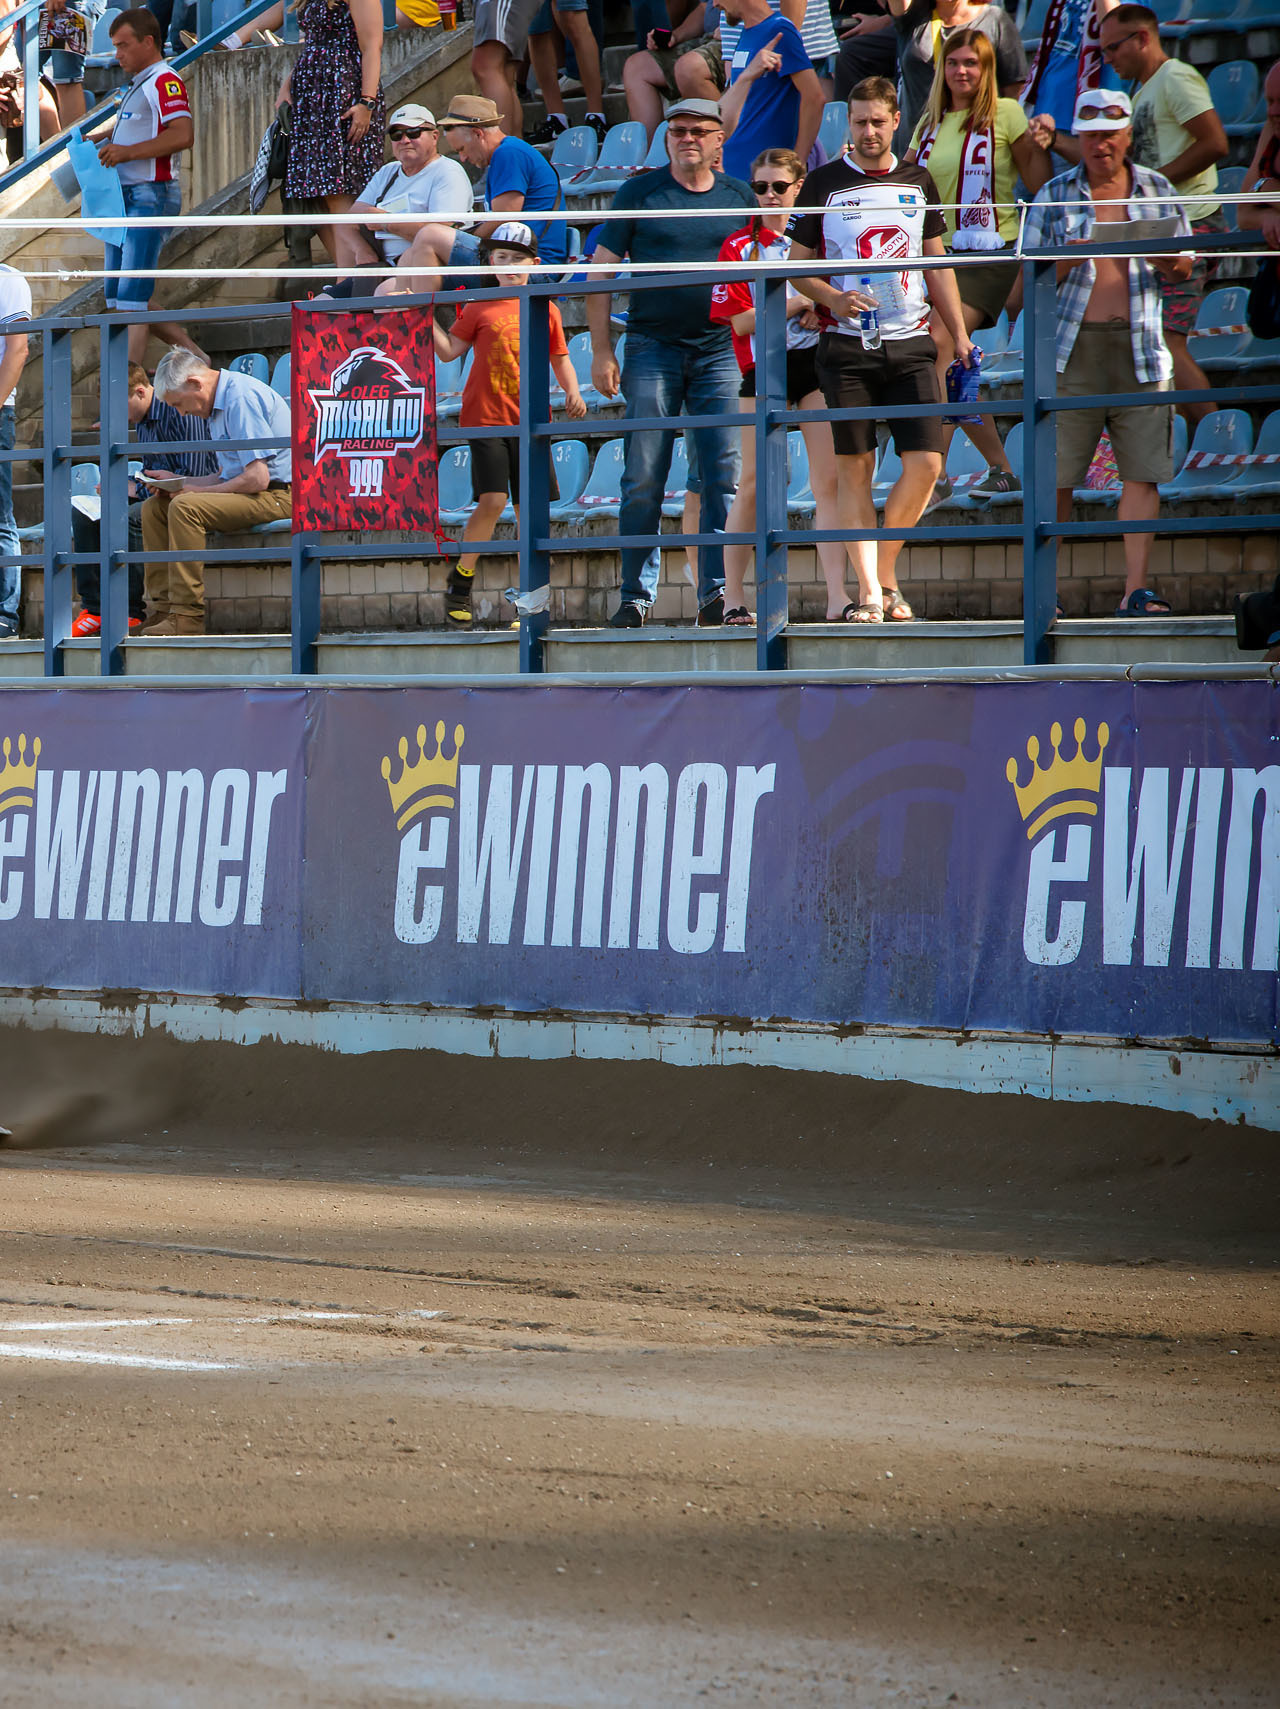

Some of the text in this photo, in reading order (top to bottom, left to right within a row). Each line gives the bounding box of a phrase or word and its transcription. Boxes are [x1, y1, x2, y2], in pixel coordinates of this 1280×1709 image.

[351, 384, 390, 400] OLEG
[343, 438, 395, 450] RACING
[454, 450, 468, 467] 37
[348, 458, 384, 497] 999
